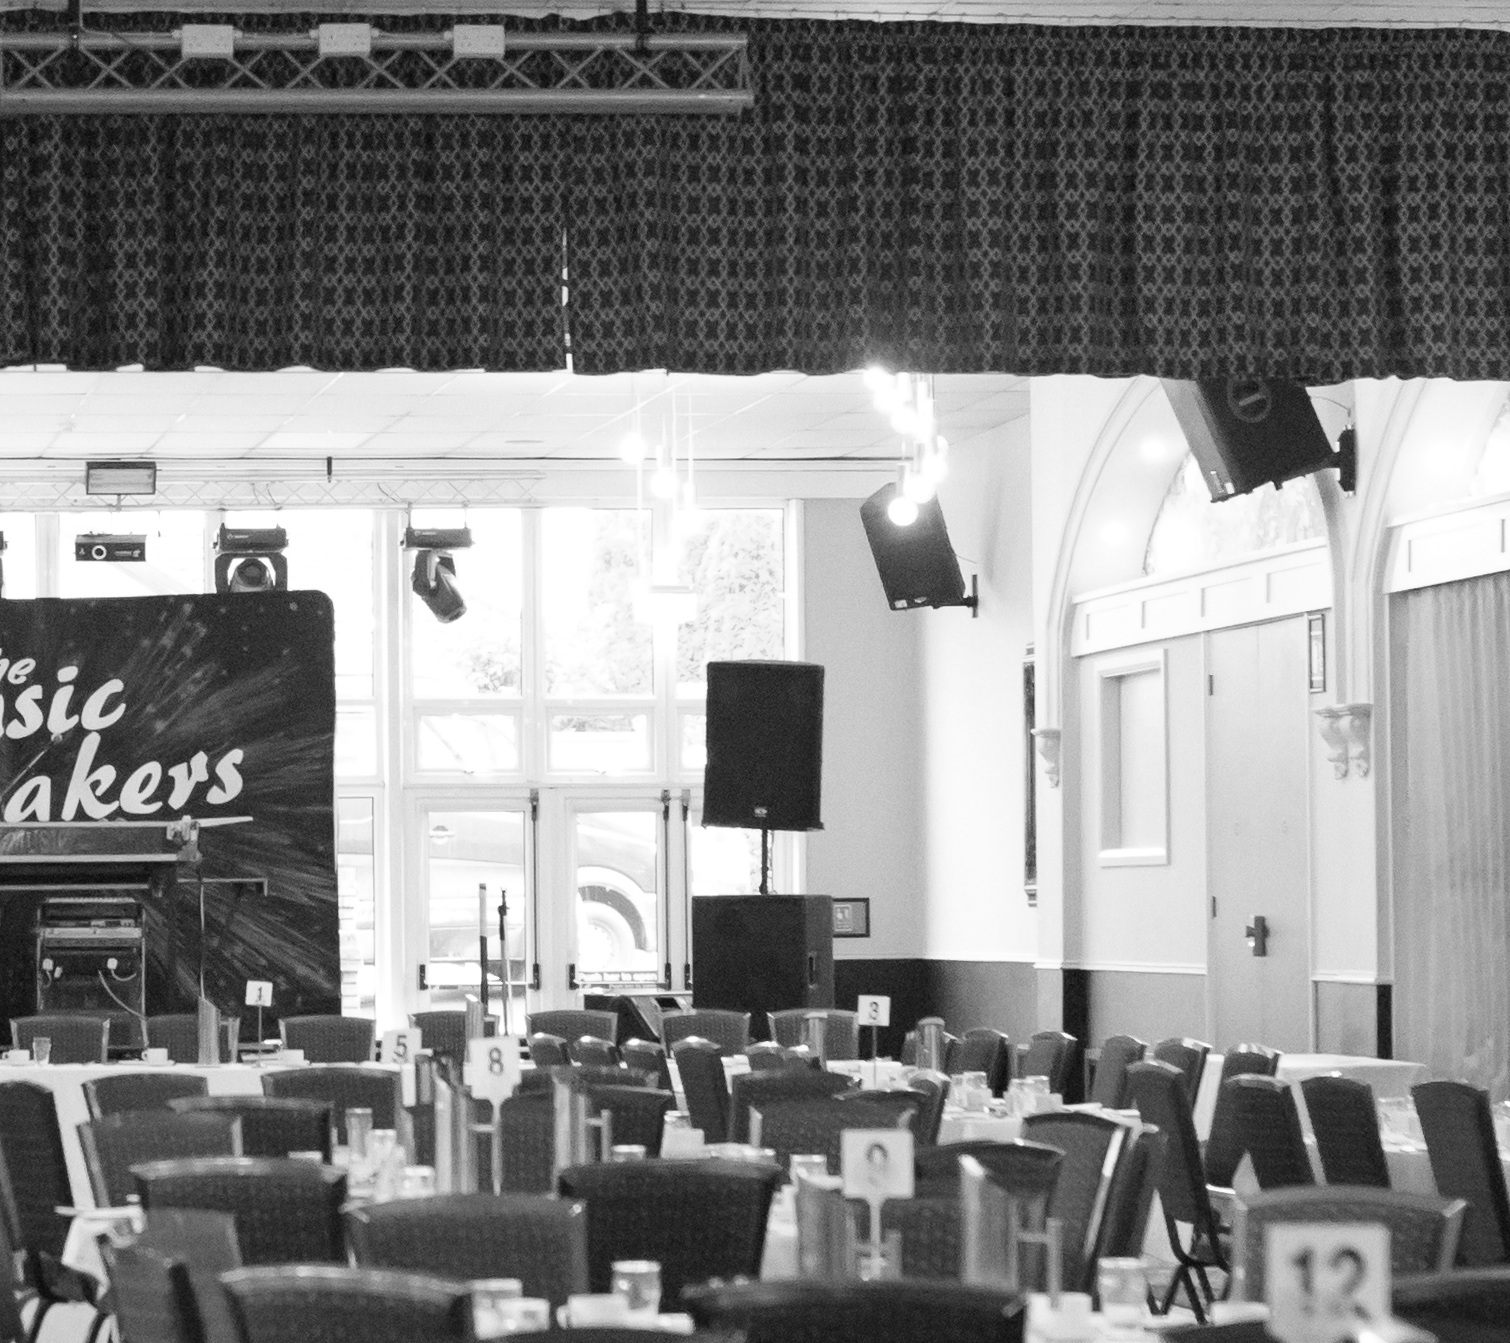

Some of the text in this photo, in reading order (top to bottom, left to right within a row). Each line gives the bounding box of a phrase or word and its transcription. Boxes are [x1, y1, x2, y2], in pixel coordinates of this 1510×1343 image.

[868, 1001, 880, 1021] 3
[393, 1034, 408, 1060] 5
[488, 1046, 505, 1077] 8
[1290, 1246, 1372, 1323] 12
